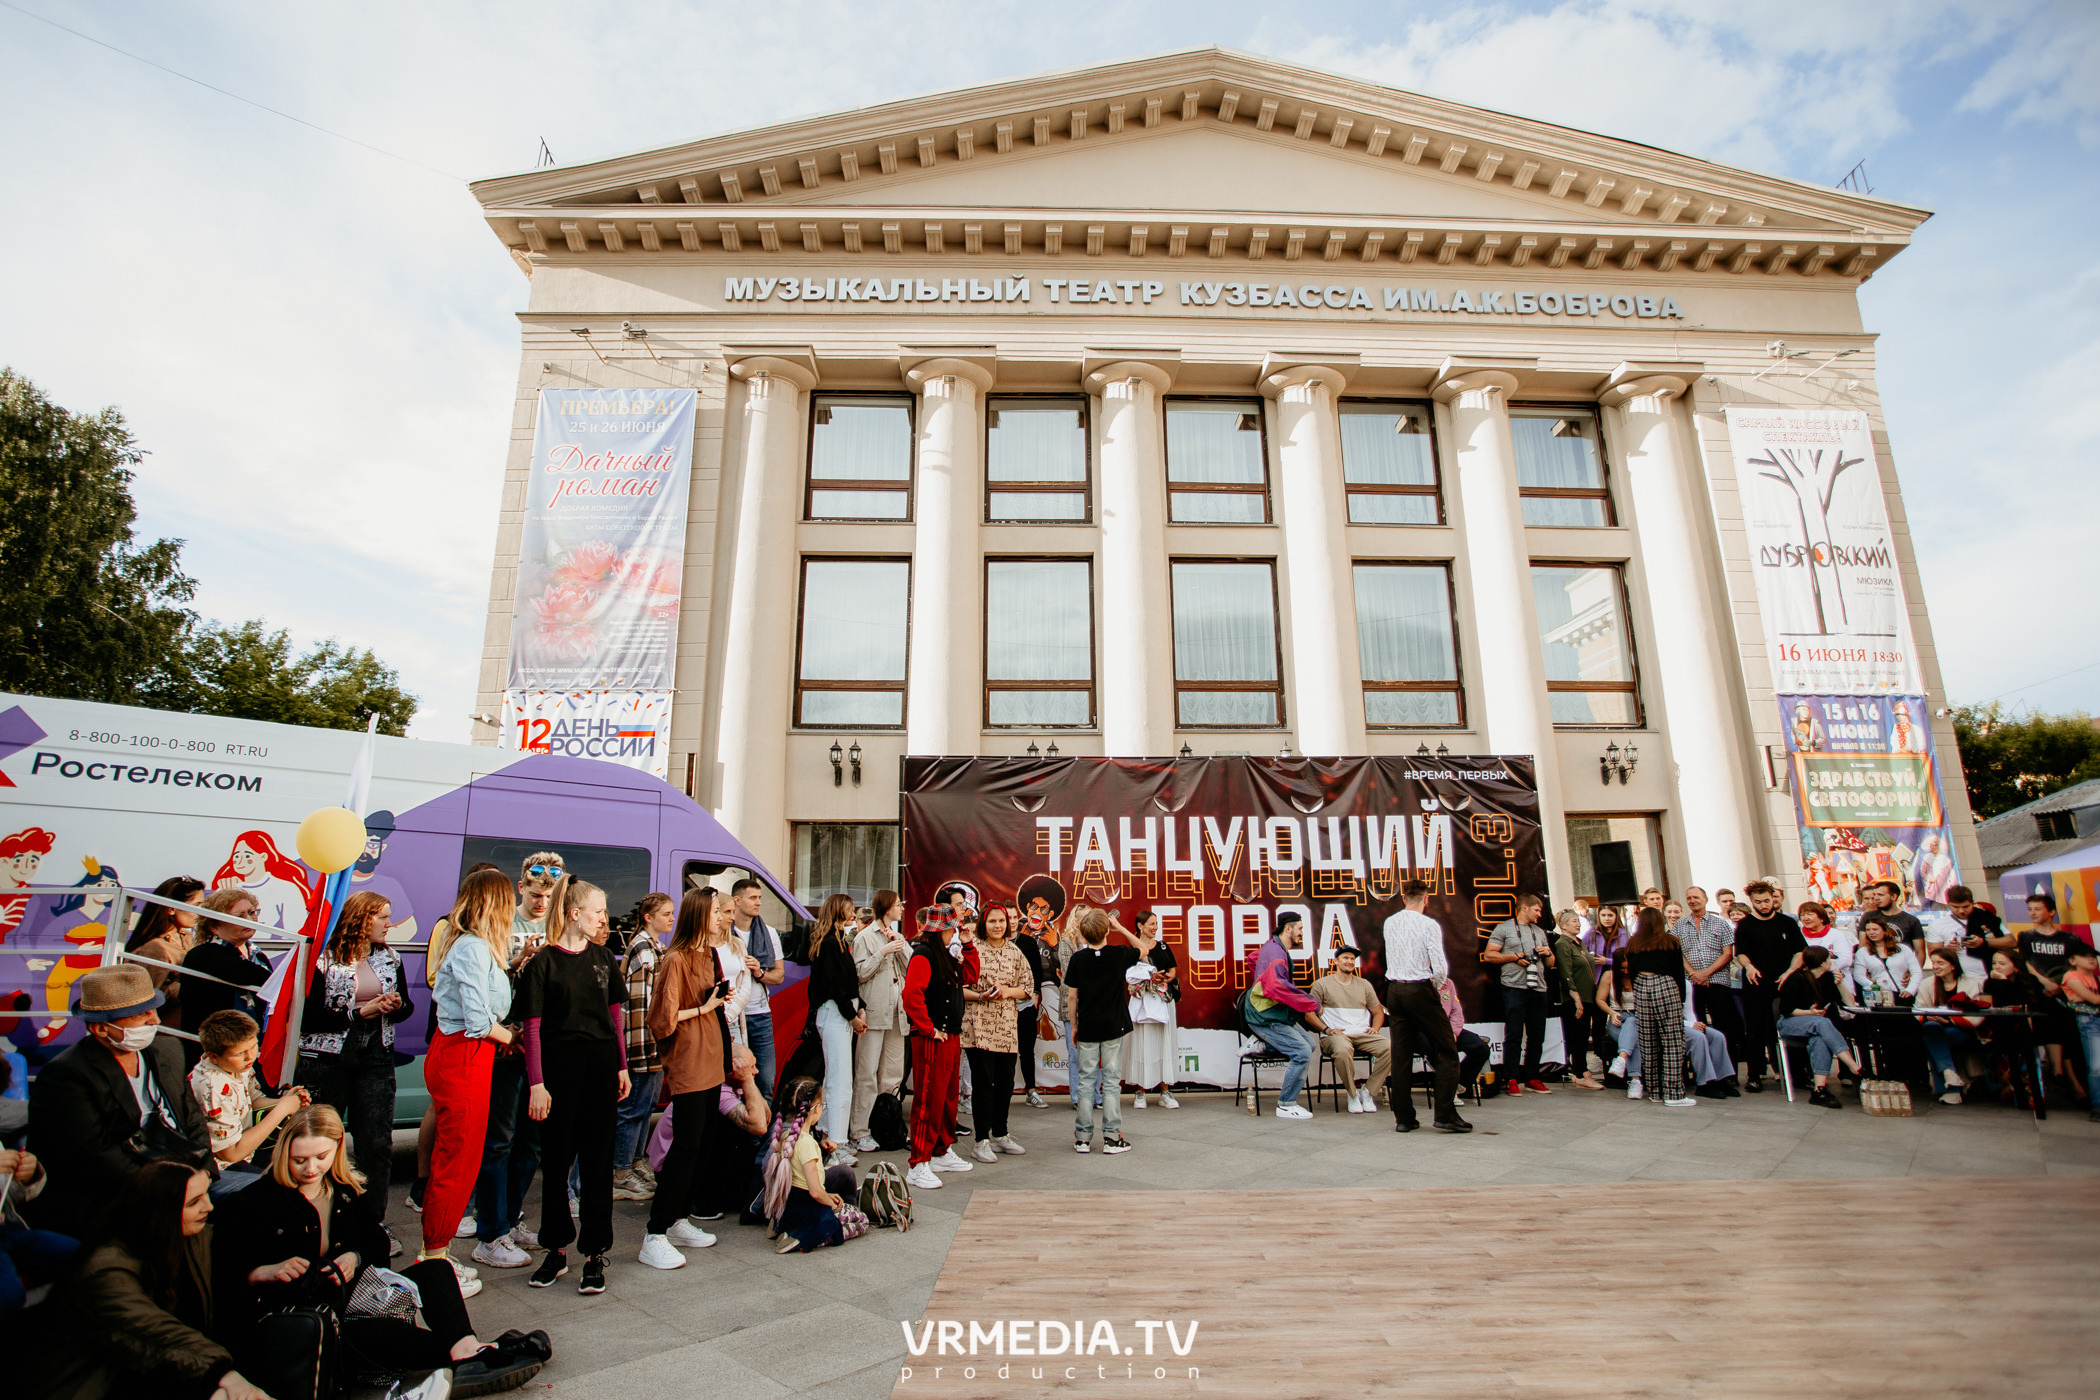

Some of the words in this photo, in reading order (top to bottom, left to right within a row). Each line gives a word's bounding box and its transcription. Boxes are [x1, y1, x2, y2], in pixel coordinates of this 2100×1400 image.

[724, 274, 1030, 302] МУЗЫКАЛЬНЫЙ
[1043, 279, 1164, 304] ТЕАТР
[1180, 282, 1374, 310] КУЗБАССА
[559, 400, 675, 416] ПРЕМЬЕРА!
[569, 421, 586, 433] 25
[600, 421, 618, 433] 26
[621, 421, 665, 433] ИЮНЯ
[1736, 417, 1785, 429] САМЫЙ
[1789, 419, 1861, 431] КАССОВЫЙ
[1762, 431, 1842, 443] СПЕКТАКЛЬ!
[546, 444, 676, 473] Дачный
[548, 477, 661, 509] роман
[1760, 537, 1892, 569] ДУБРОВСКИЙ
[1856, 577, 1894, 586] МЮЗИКЛ
[1778, 643, 1801, 662] 16
[1807, 648, 1867, 662] ИЮНЯ
[1873, 652, 1903, 663] 18:30
[1822, 703, 1843, 720] 15
[1859, 703, 1880, 720] 16
[516, 718, 552, 750] 12
[551, 718, 621, 737] ДЕНЬ
[1828, 724, 1880, 739] ИЮНЯ
[69, 729, 216, 753] 8-800-100-0-800
[225, 744, 268, 758] RT.RU
[551, 737, 656, 757] РОССИИ
[31, 752, 263, 792] Ростелеком
[1403, 770, 1508, 782] #ВРЕМЯ_ПЕРВЫХ
[1809, 768, 1924, 790] ЗДРАВСТВУЙ,
[1809, 791, 1927, 808] СВЕТОФОРИК!
[1036, 799, 1455, 880] ТАНЦУЮЩИЙ
[2031, 942, 2065, 956] LEADER
